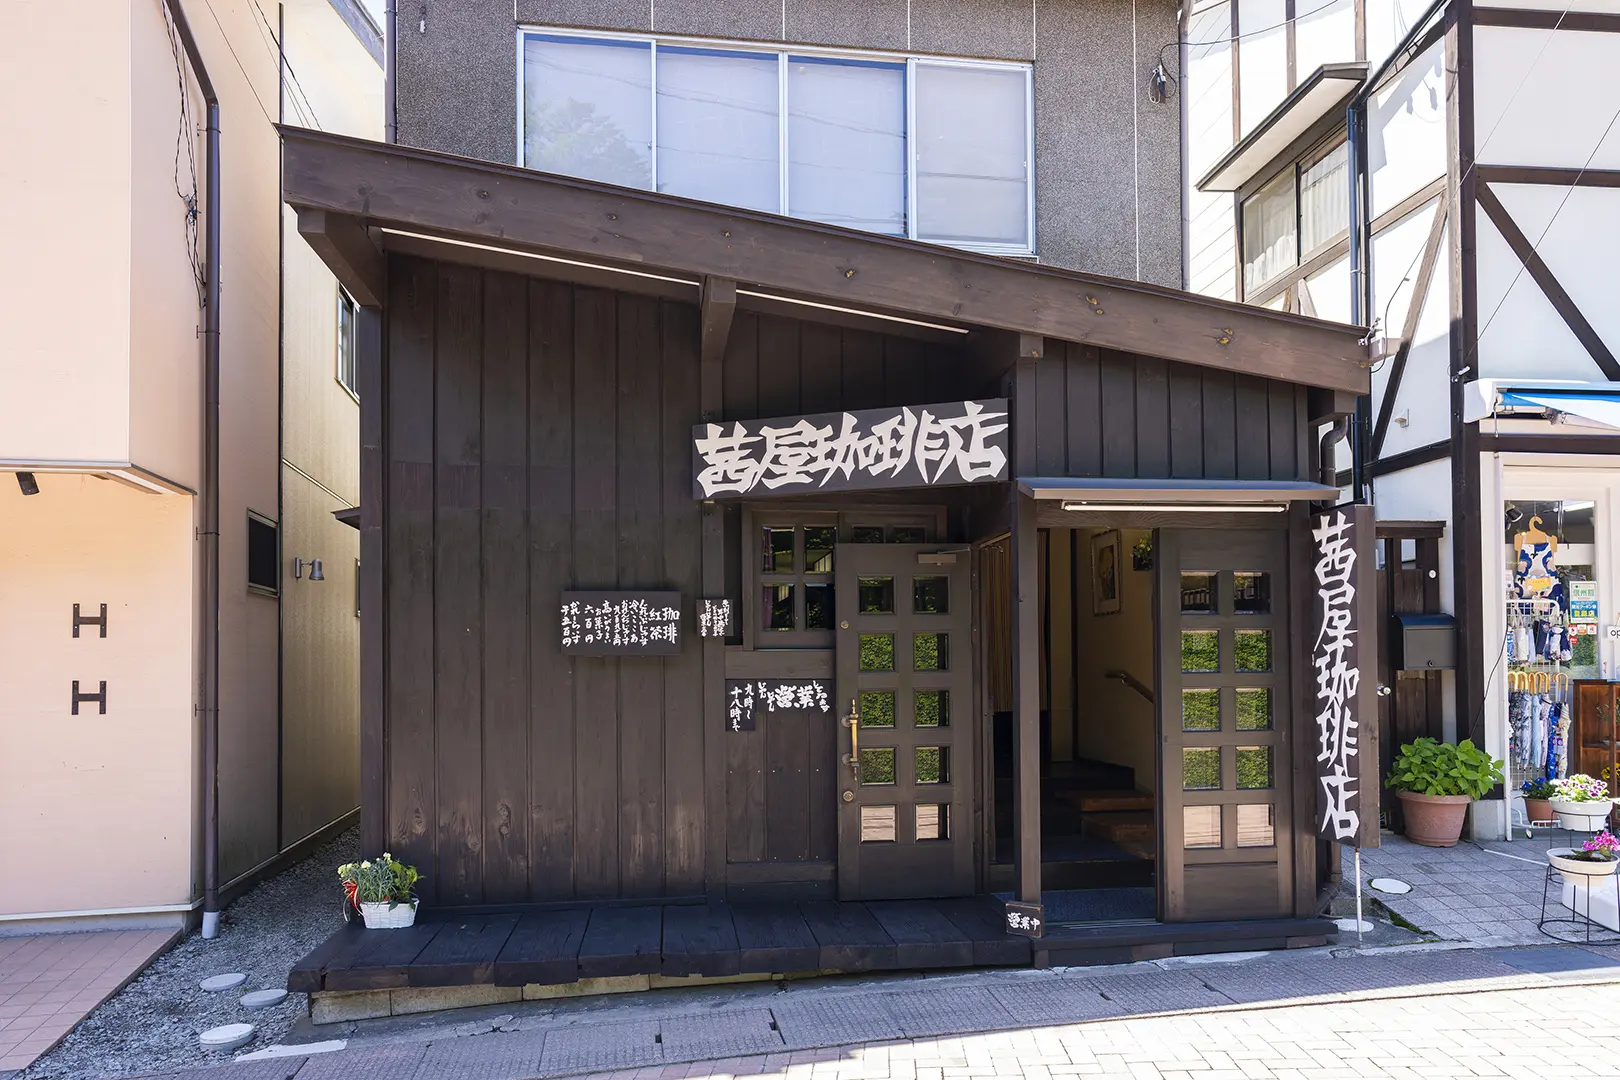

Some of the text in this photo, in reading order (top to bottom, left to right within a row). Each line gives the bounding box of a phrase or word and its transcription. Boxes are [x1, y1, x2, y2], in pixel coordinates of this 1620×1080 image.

[695, 401, 1008, 498] 茜屋珈琲店
[561, 605, 571, 647] 千五百円
[584, 604, 595, 644] 六百円
[594, 608, 604, 640] お菓子
[648, 608, 663, 641] 紅茶
[661, 606, 680, 644] 珈琲
[1312, 511, 1360, 838] 茜屋珈琲店
[775, 684, 815, 709] 営業
[1007, 912, 1041, 931] 営業中
